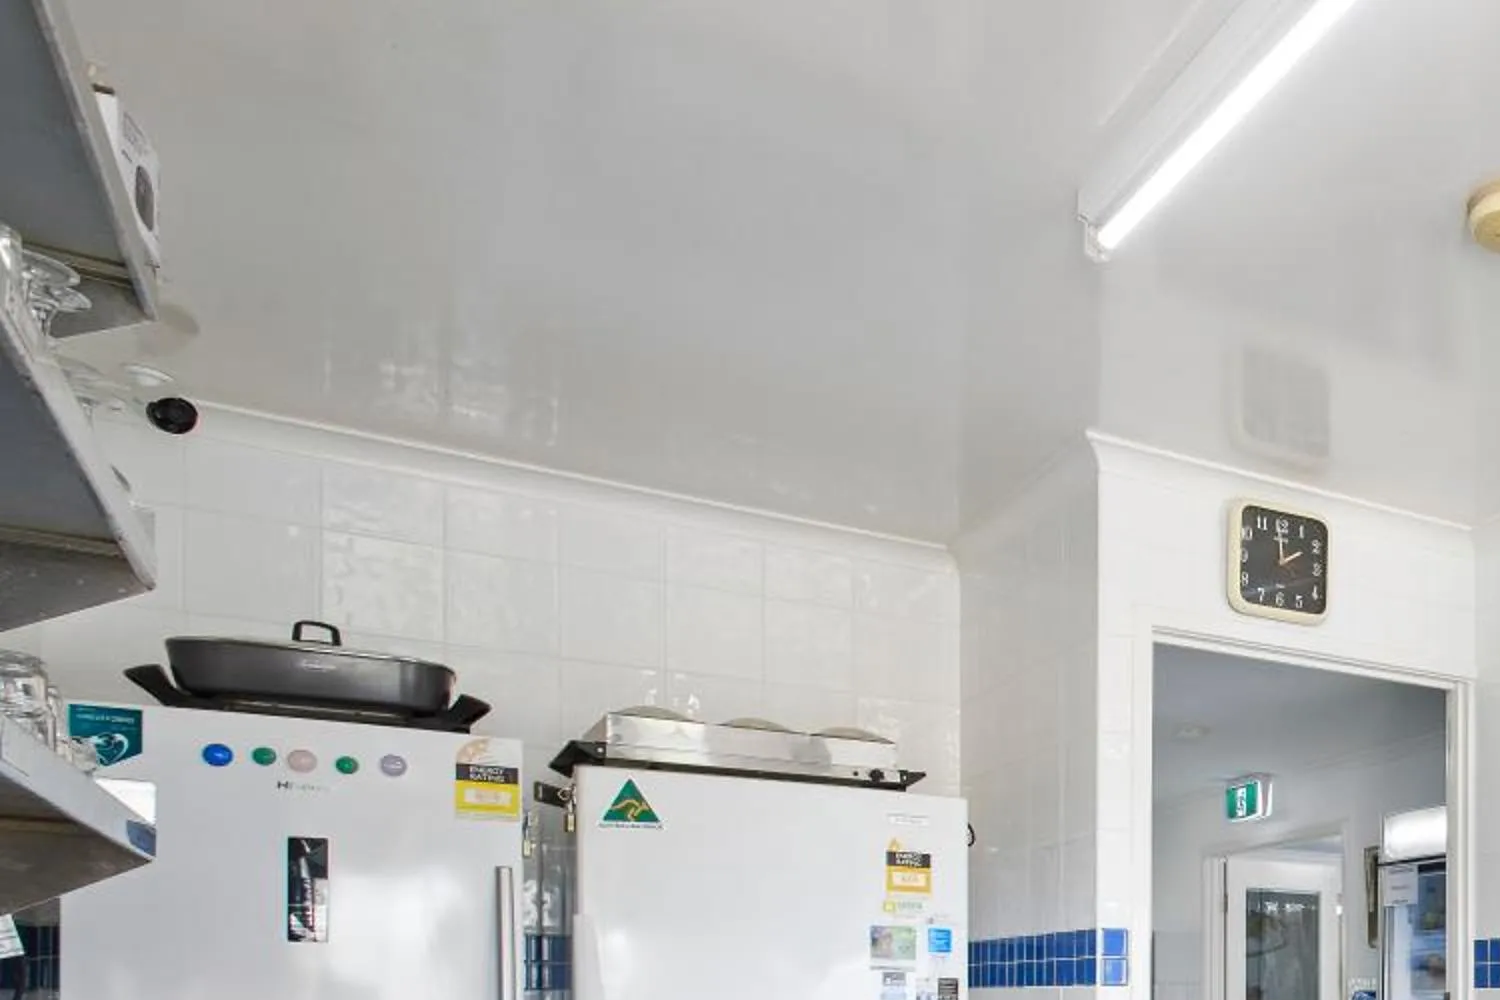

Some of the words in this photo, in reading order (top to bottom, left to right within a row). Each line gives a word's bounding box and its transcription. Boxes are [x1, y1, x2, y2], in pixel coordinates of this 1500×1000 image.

[1257, 516, 1267, 530] 11
[1276, 518, 1288, 533] 12
[1241, 527, 1252, 540] 10
[1312, 540, 1321, 553] 2
[1241, 549, 1248, 562] 9
[1312, 563, 1321, 576] 3
[1241, 572, 1249, 586] 8
[1257, 587, 1265, 602] 7
[1275, 591, 1285, 606] 6
[1311, 586, 1322, 600] 4
[1295, 595, 1304, 609] 5
